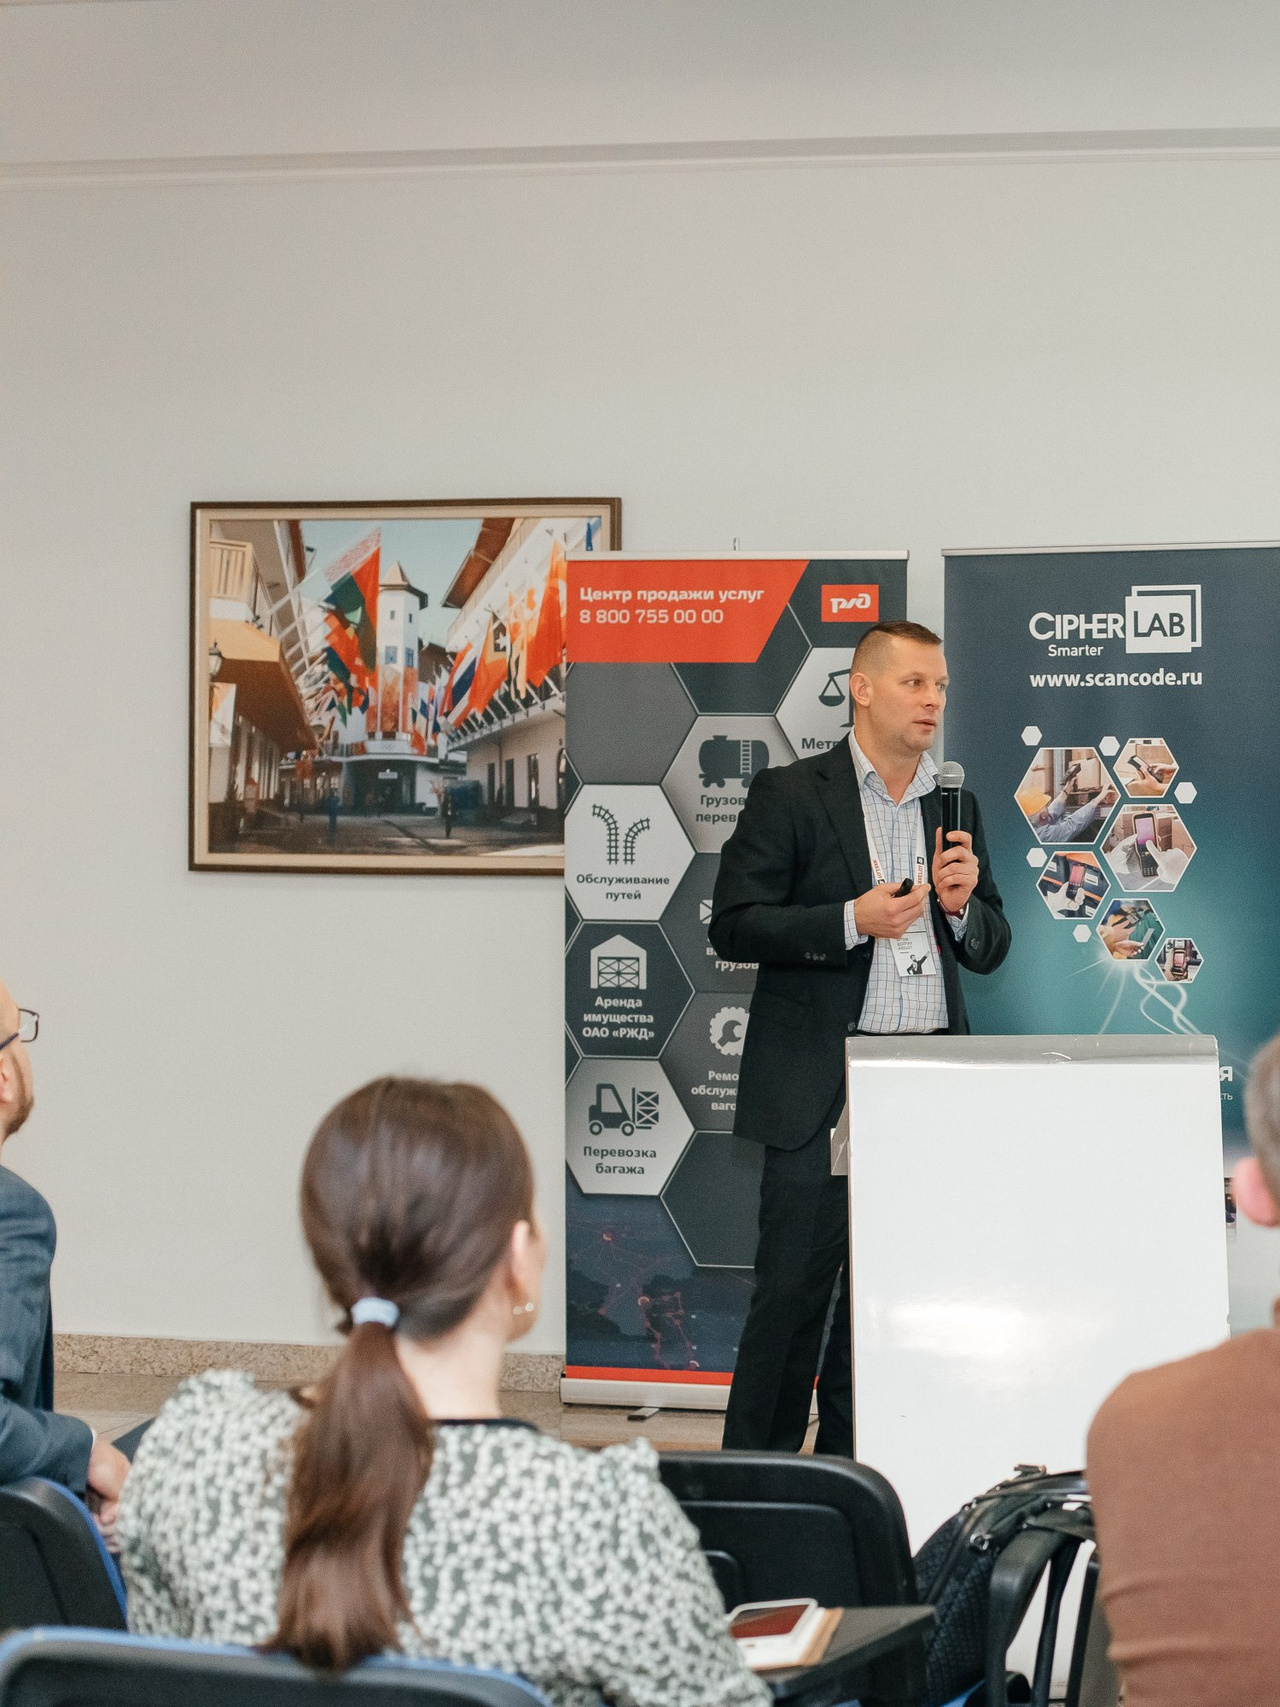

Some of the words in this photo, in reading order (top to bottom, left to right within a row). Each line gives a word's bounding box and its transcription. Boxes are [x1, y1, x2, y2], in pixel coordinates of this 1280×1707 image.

[579, 587, 632, 602] Центр
[637, 589, 714, 602] продажи
[719, 589, 765, 602] услуг
[579, 609, 590, 624] 8
[596, 609, 630, 624] 800
[637, 609, 669, 624] 755
[674, 609, 696, 624] 00
[701, 609, 723, 624] 00
[1048, 644, 1104, 657] Smarter
[1029, 668, 1203, 687] www.scancode.ru
[695, 813, 737, 825] перев
[576, 873, 670, 886] Обслуживание
[605, 889, 642, 901] путей
[595, 996, 643, 1008] Аренда
[583, 1014, 653, 1024] имущества
[582, 1027, 609, 1038] ОАО
[583, 1147, 657, 1159] Перевозка
[595, 1162, 645, 1175] багажа
